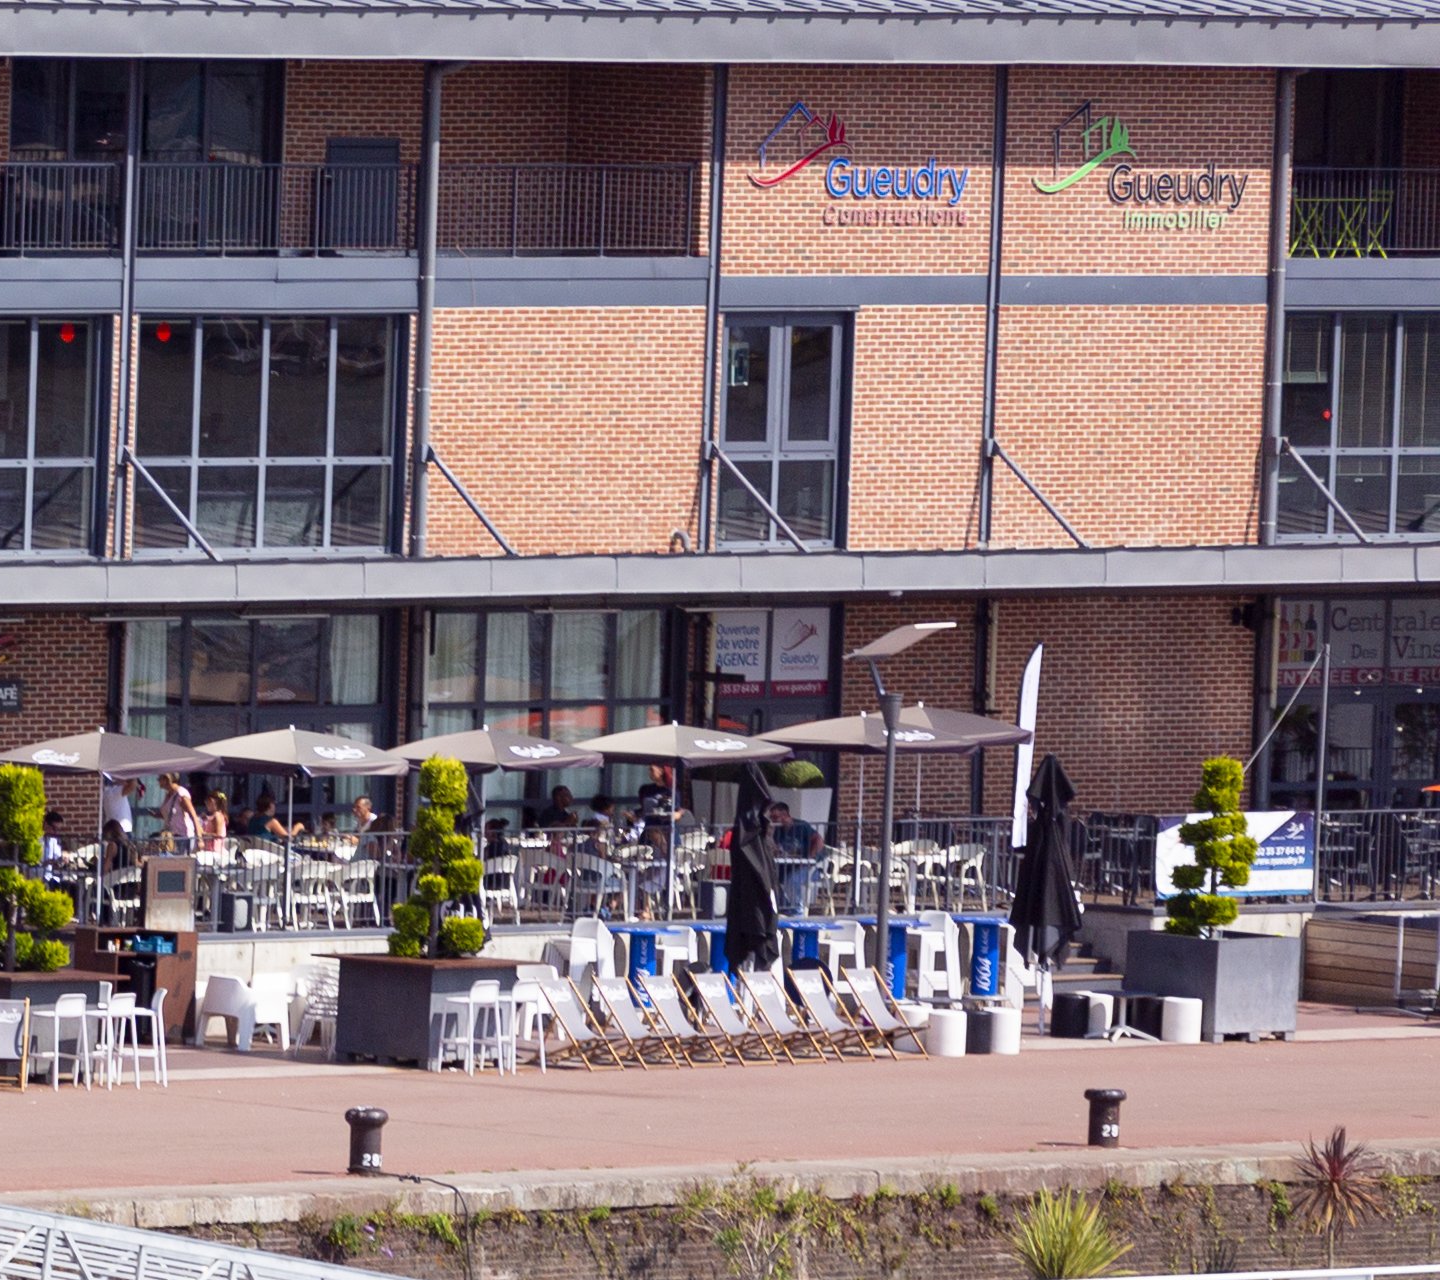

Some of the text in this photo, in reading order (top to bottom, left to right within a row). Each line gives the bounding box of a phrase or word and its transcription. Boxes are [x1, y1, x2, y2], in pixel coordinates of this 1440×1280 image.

[825, 156, 969, 206] Gueudry
[1108, 161, 1249, 210] Gueudry
[716, 623, 760, 636] Ouverture
[716, 637, 730, 650] de
